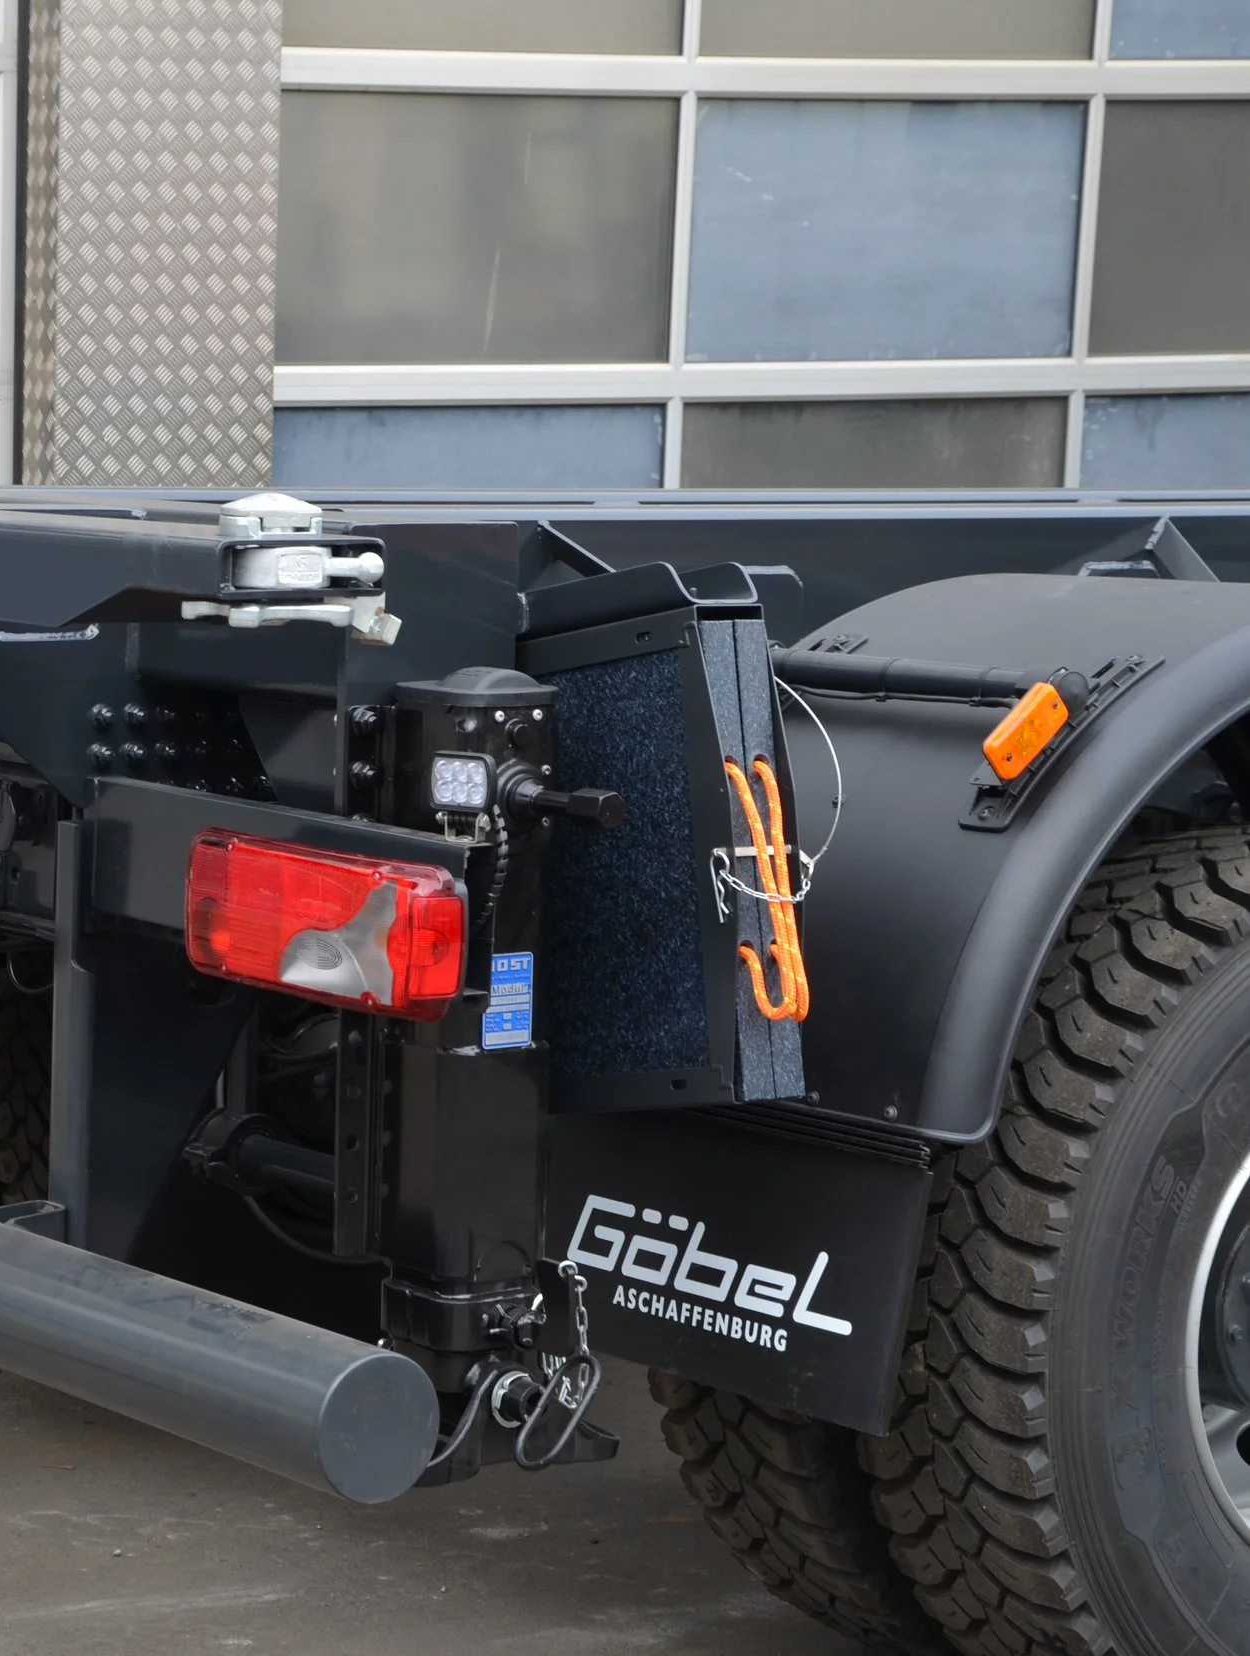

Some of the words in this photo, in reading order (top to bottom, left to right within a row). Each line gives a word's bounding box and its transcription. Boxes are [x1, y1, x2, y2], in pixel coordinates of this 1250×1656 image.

[1170, 1179, 1187, 1216] HD
[1111, 1155, 1175, 1354] WORKS
[612, 1285, 788, 1352] ASCHAFFENBURG
